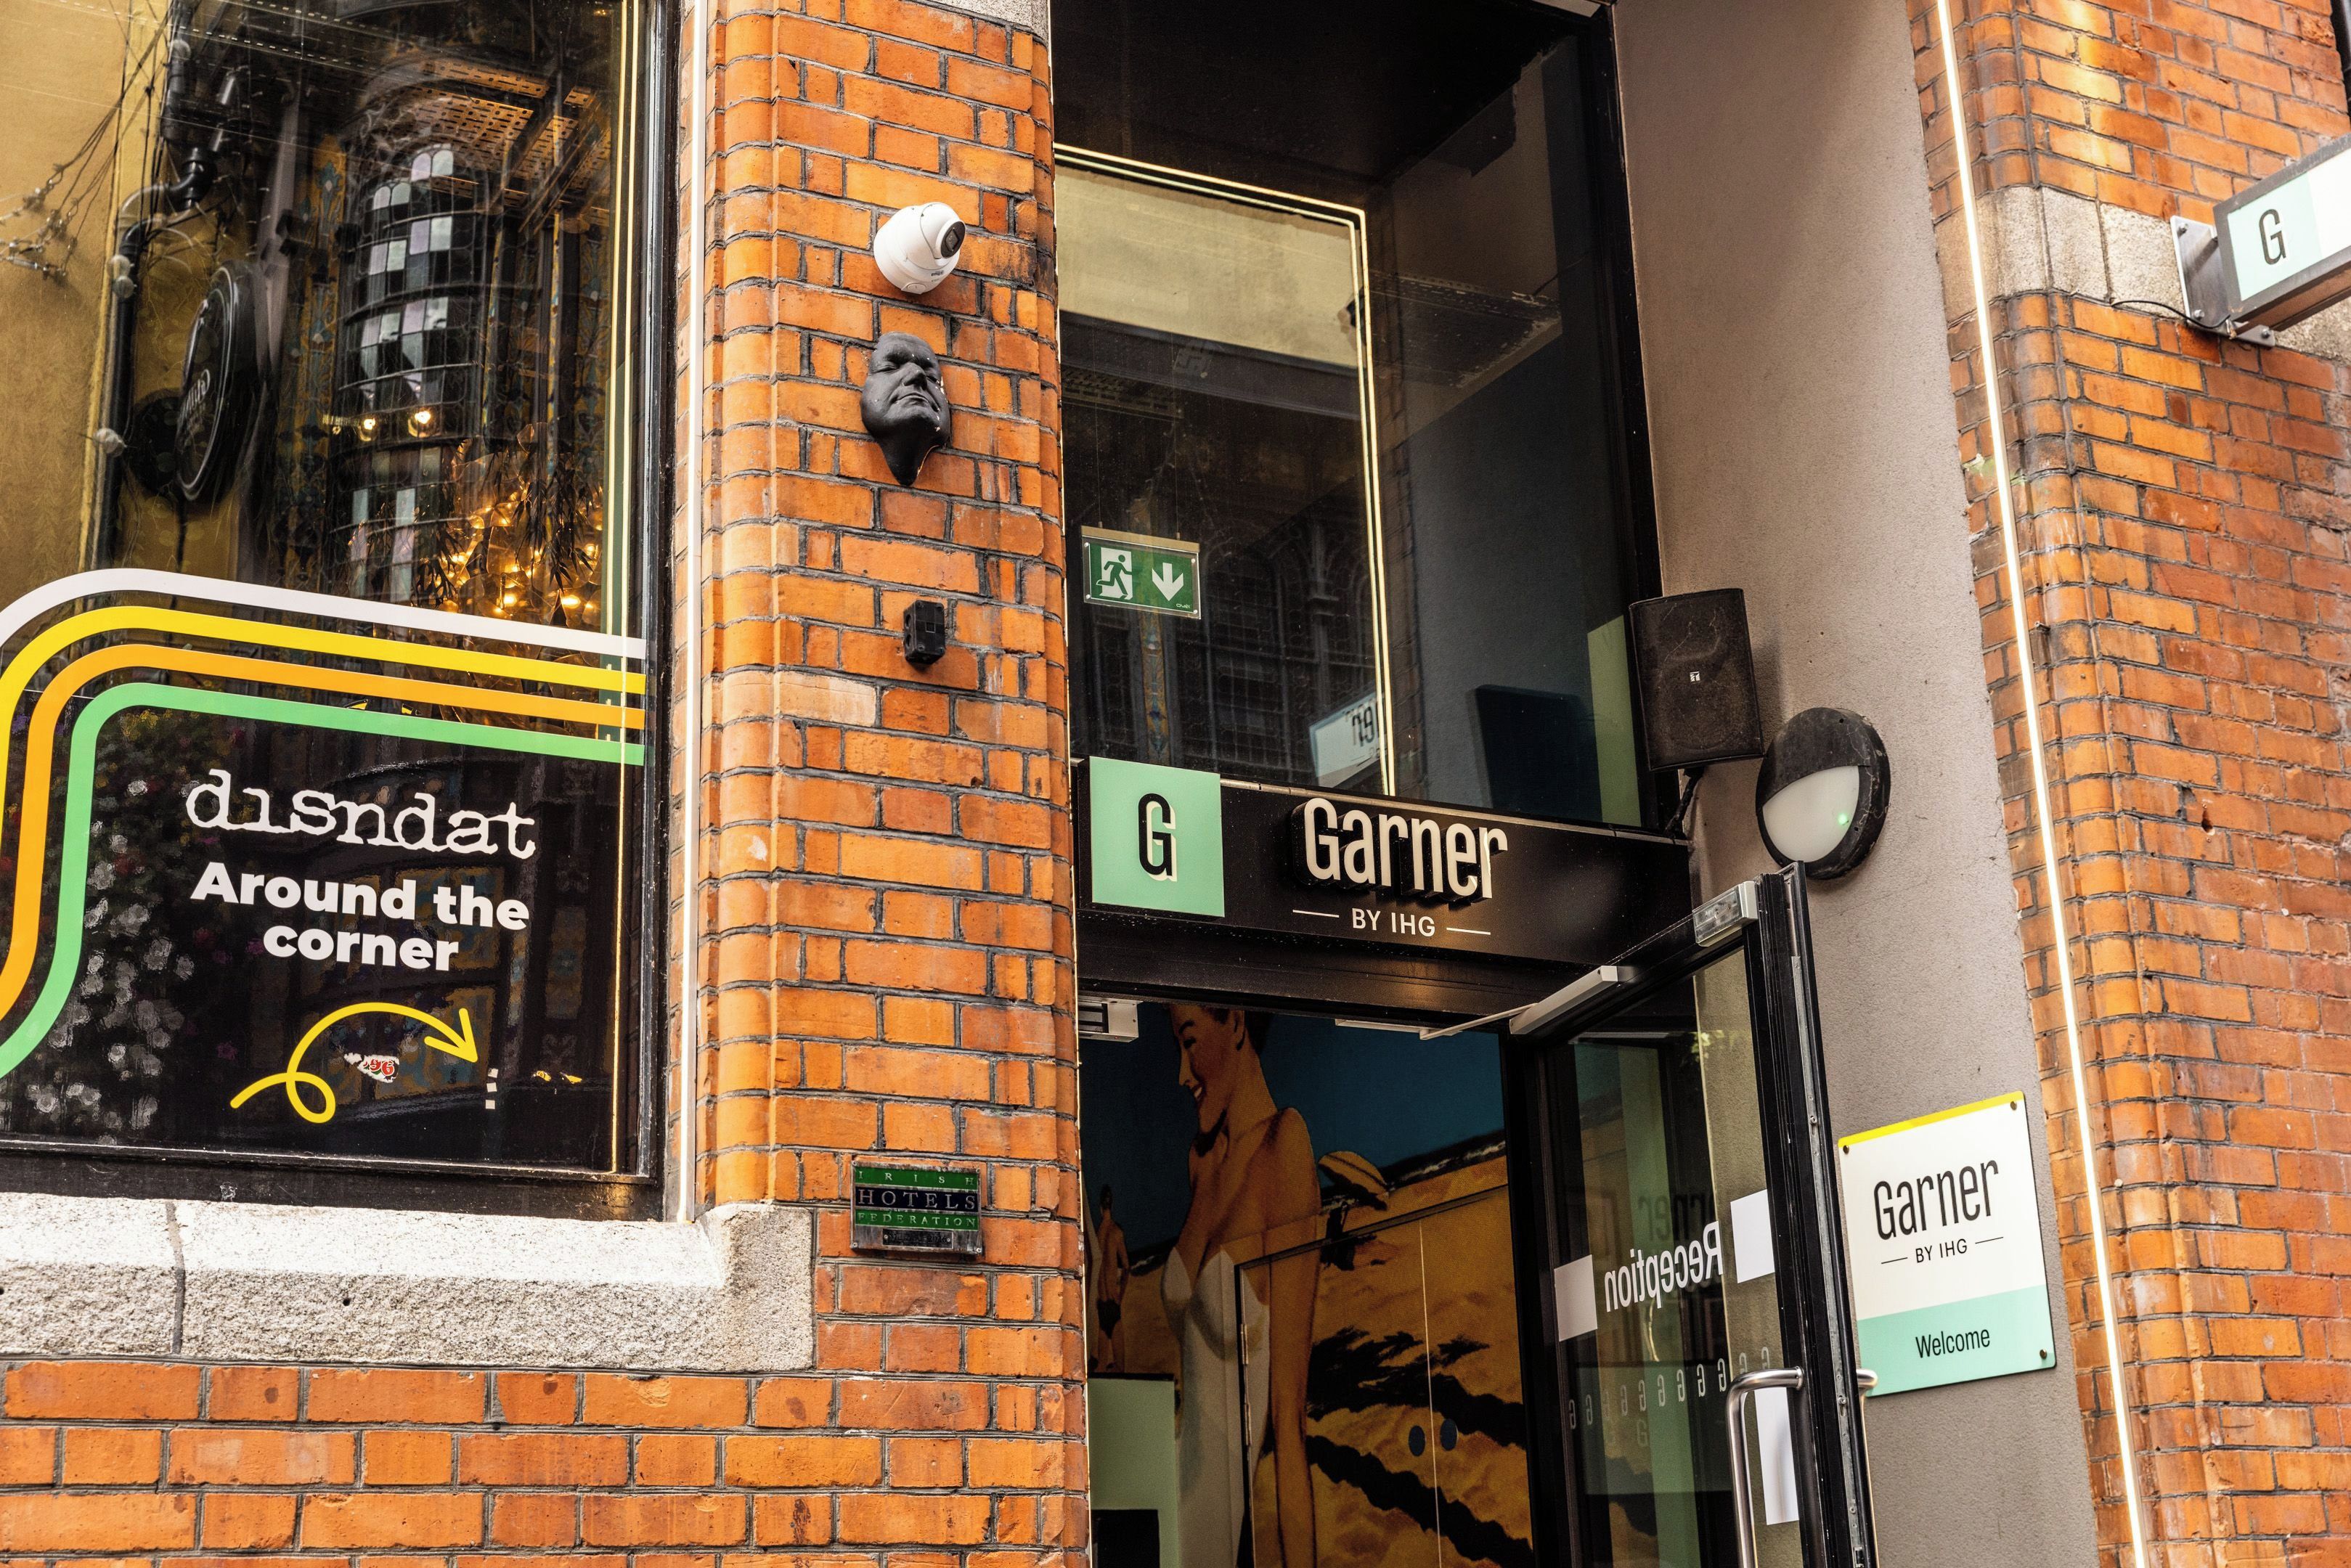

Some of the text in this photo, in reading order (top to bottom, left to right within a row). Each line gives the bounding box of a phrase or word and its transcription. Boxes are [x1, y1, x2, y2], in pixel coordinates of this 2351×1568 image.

[2258, 208, 2286, 266] G
[1138, 793, 1178, 882] G
[1303, 798, 1508, 899] Garner
[190, 862, 530, 931] Around the
[1352, 908, 1436, 937] BY IHG
[263, 926, 459, 971] corner
[857, 1171, 974, 1186] IRISH
[857, 1188, 976, 1210] HOTELS
[1873, 1159, 1999, 1241] Garner
[857, 1212, 977, 1228] FEDERATION
[1915, 1238, 1968, 1263] BY IHG
[1915, 1328, 1991, 1358] Welcome
